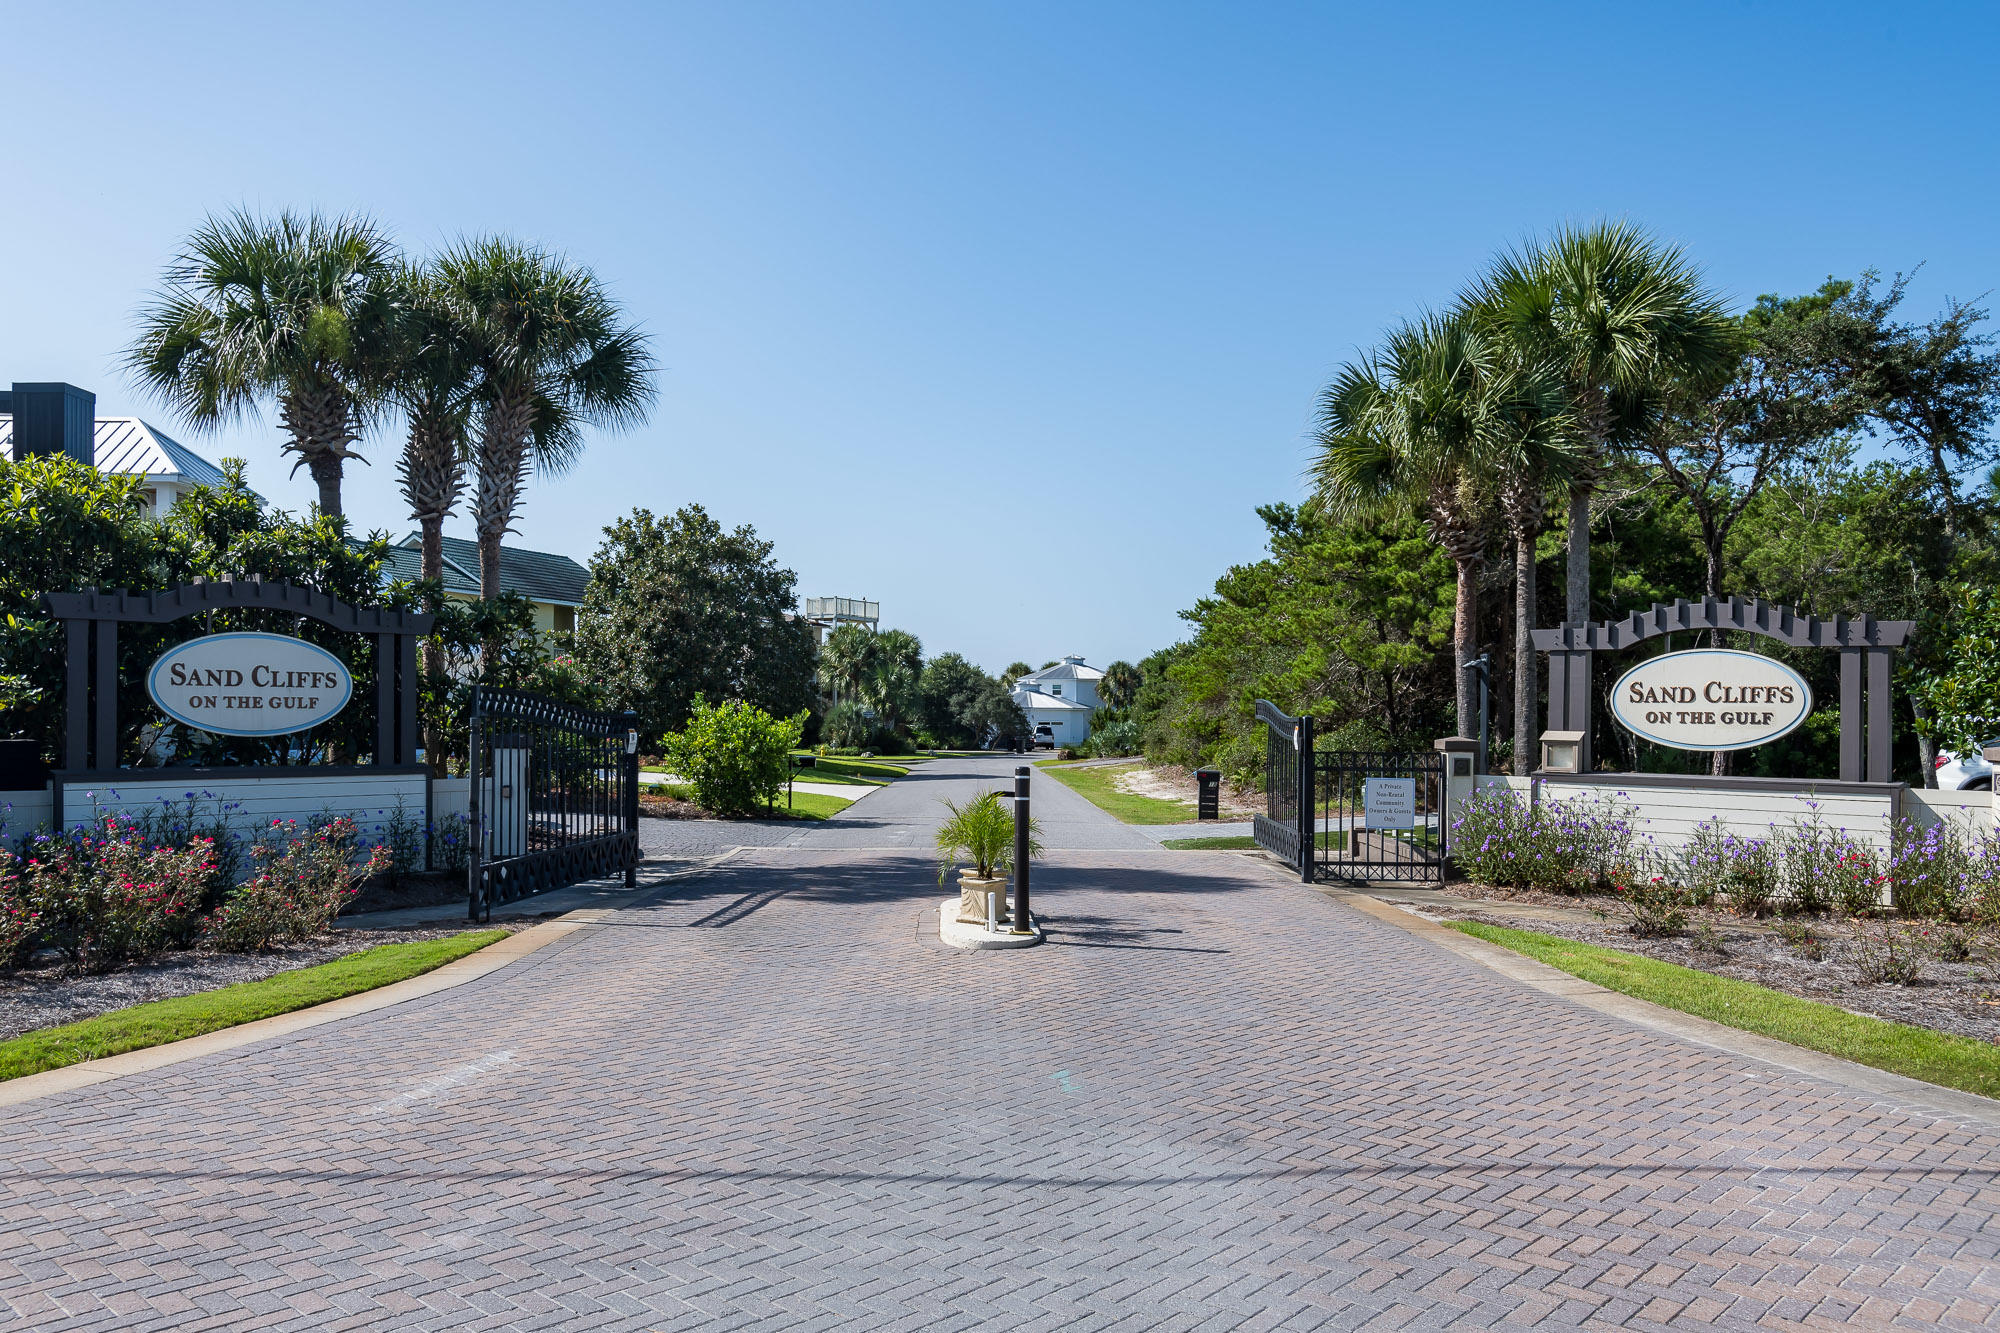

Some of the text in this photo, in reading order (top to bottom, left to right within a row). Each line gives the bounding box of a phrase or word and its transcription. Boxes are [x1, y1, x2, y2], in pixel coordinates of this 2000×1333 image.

[170, 662, 338, 689] SAND CLIFFS
[1629, 680, 1795, 704] SAND CLIFFS
[189, 695, 320, 710] ON THE GULF
[1645, 711, 1775, 726] ON THE GULF
[1384, 815, 1396, 823] Only
